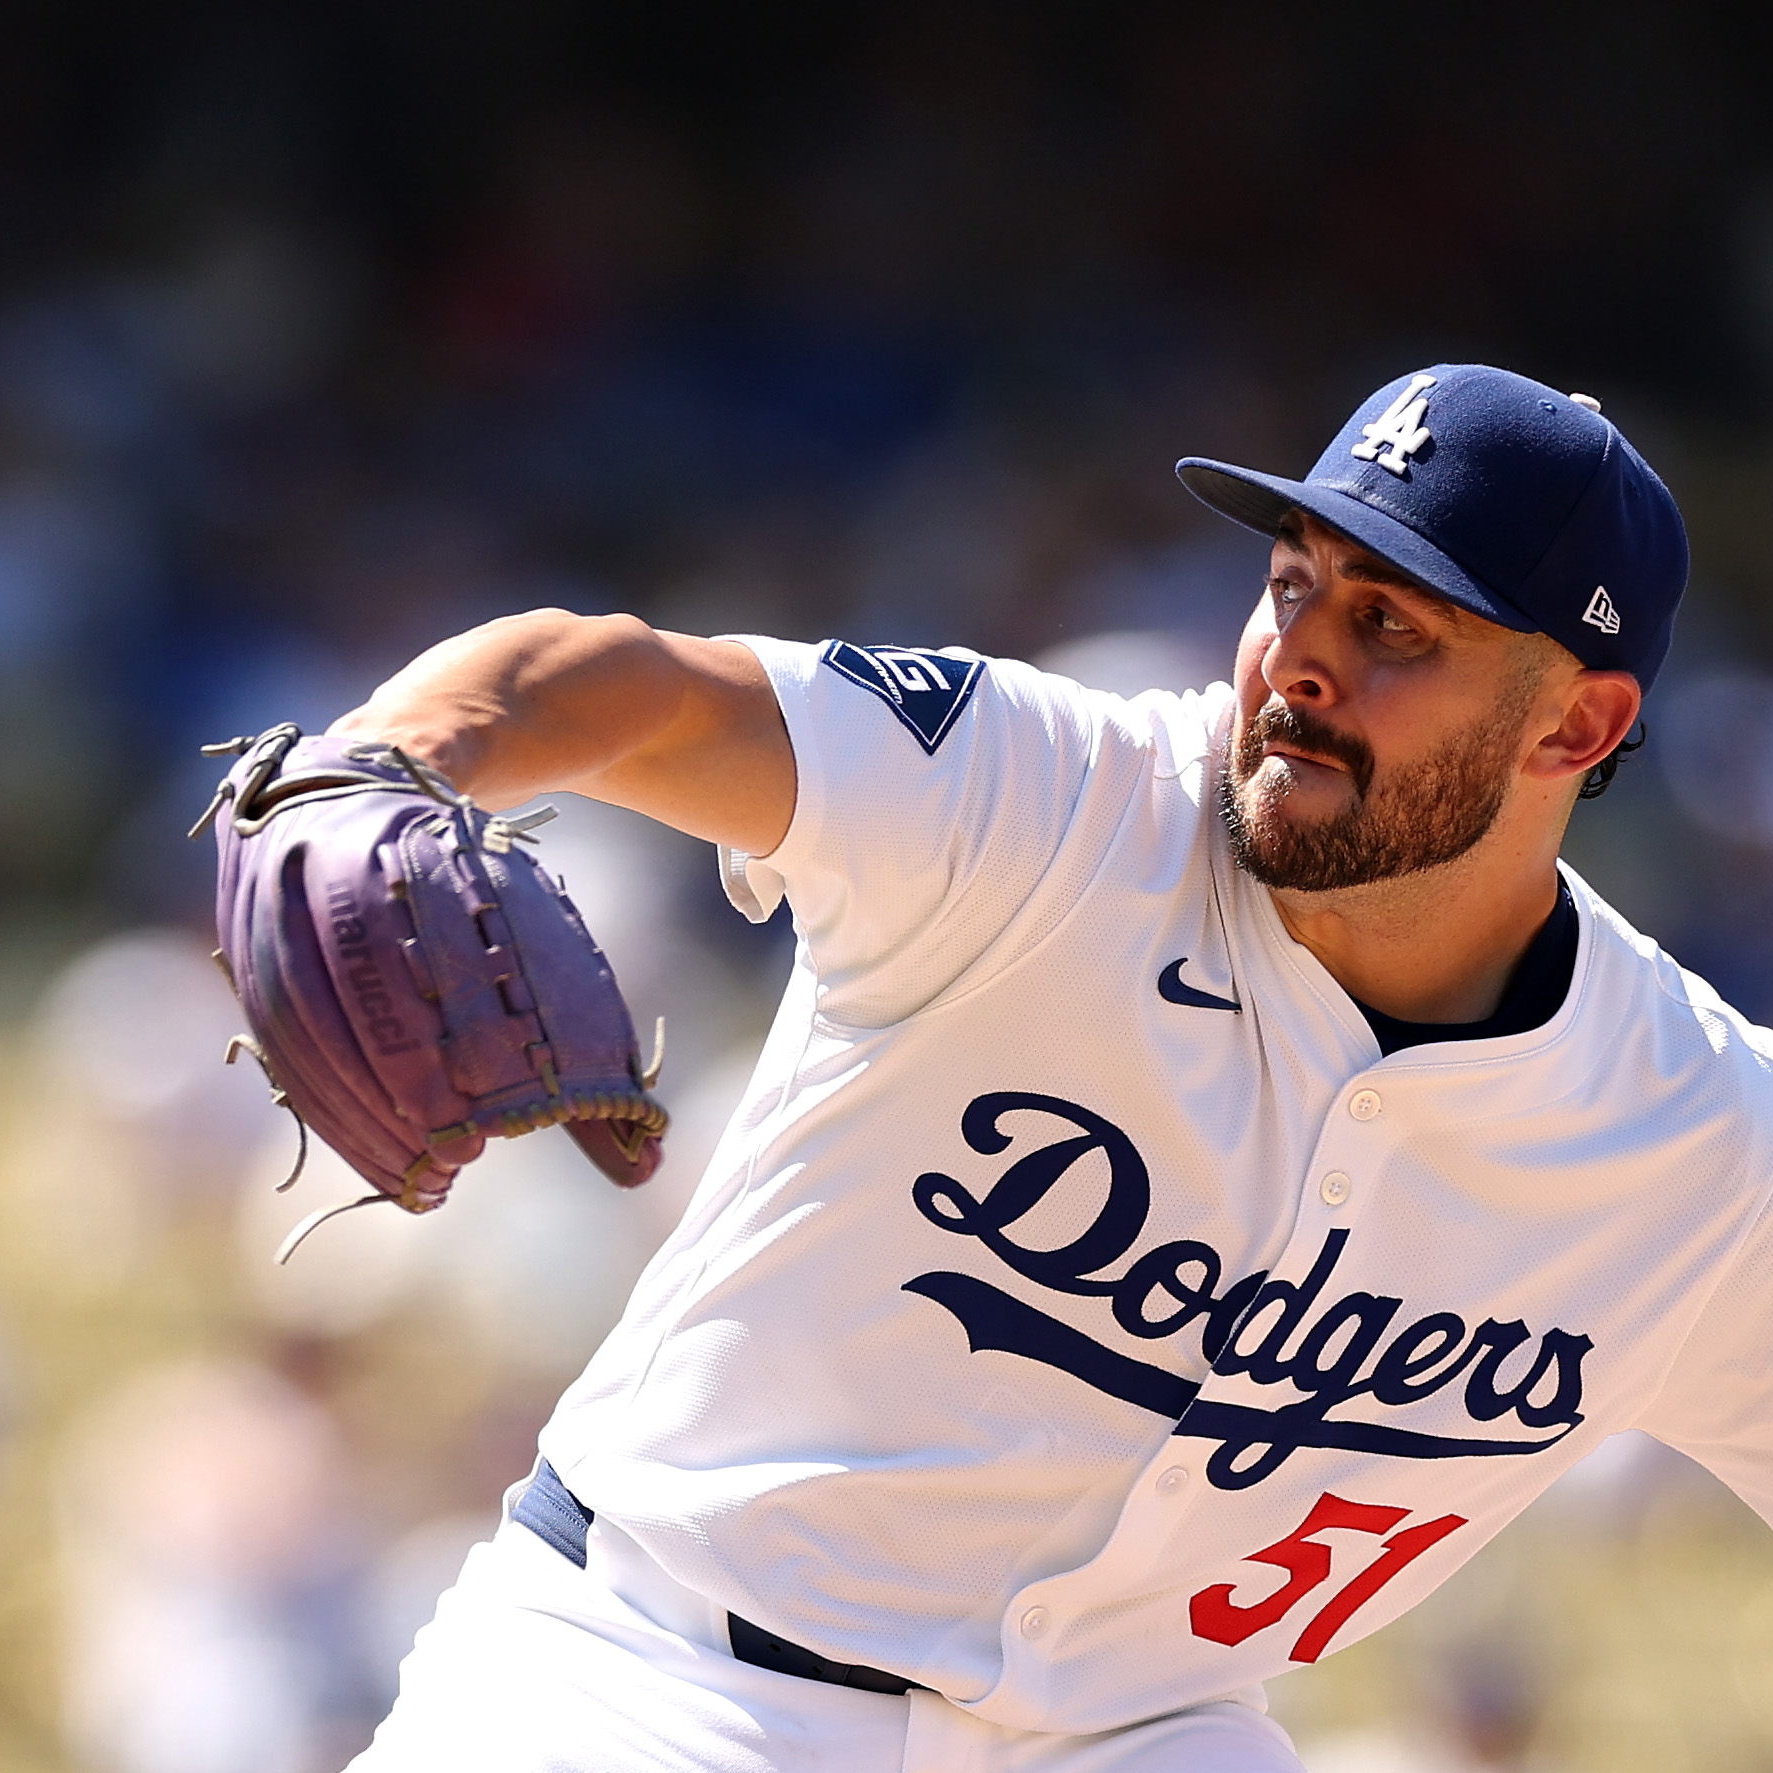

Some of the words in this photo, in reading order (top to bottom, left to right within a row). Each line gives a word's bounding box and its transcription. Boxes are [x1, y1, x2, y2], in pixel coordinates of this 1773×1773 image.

[1350, 374, 1437, 476] LA
[328, 880, 421, 1057] marucci
[911, 1091, 1595, 1490] Dodgers
[1189, 1491, 1469, 1664] 51
